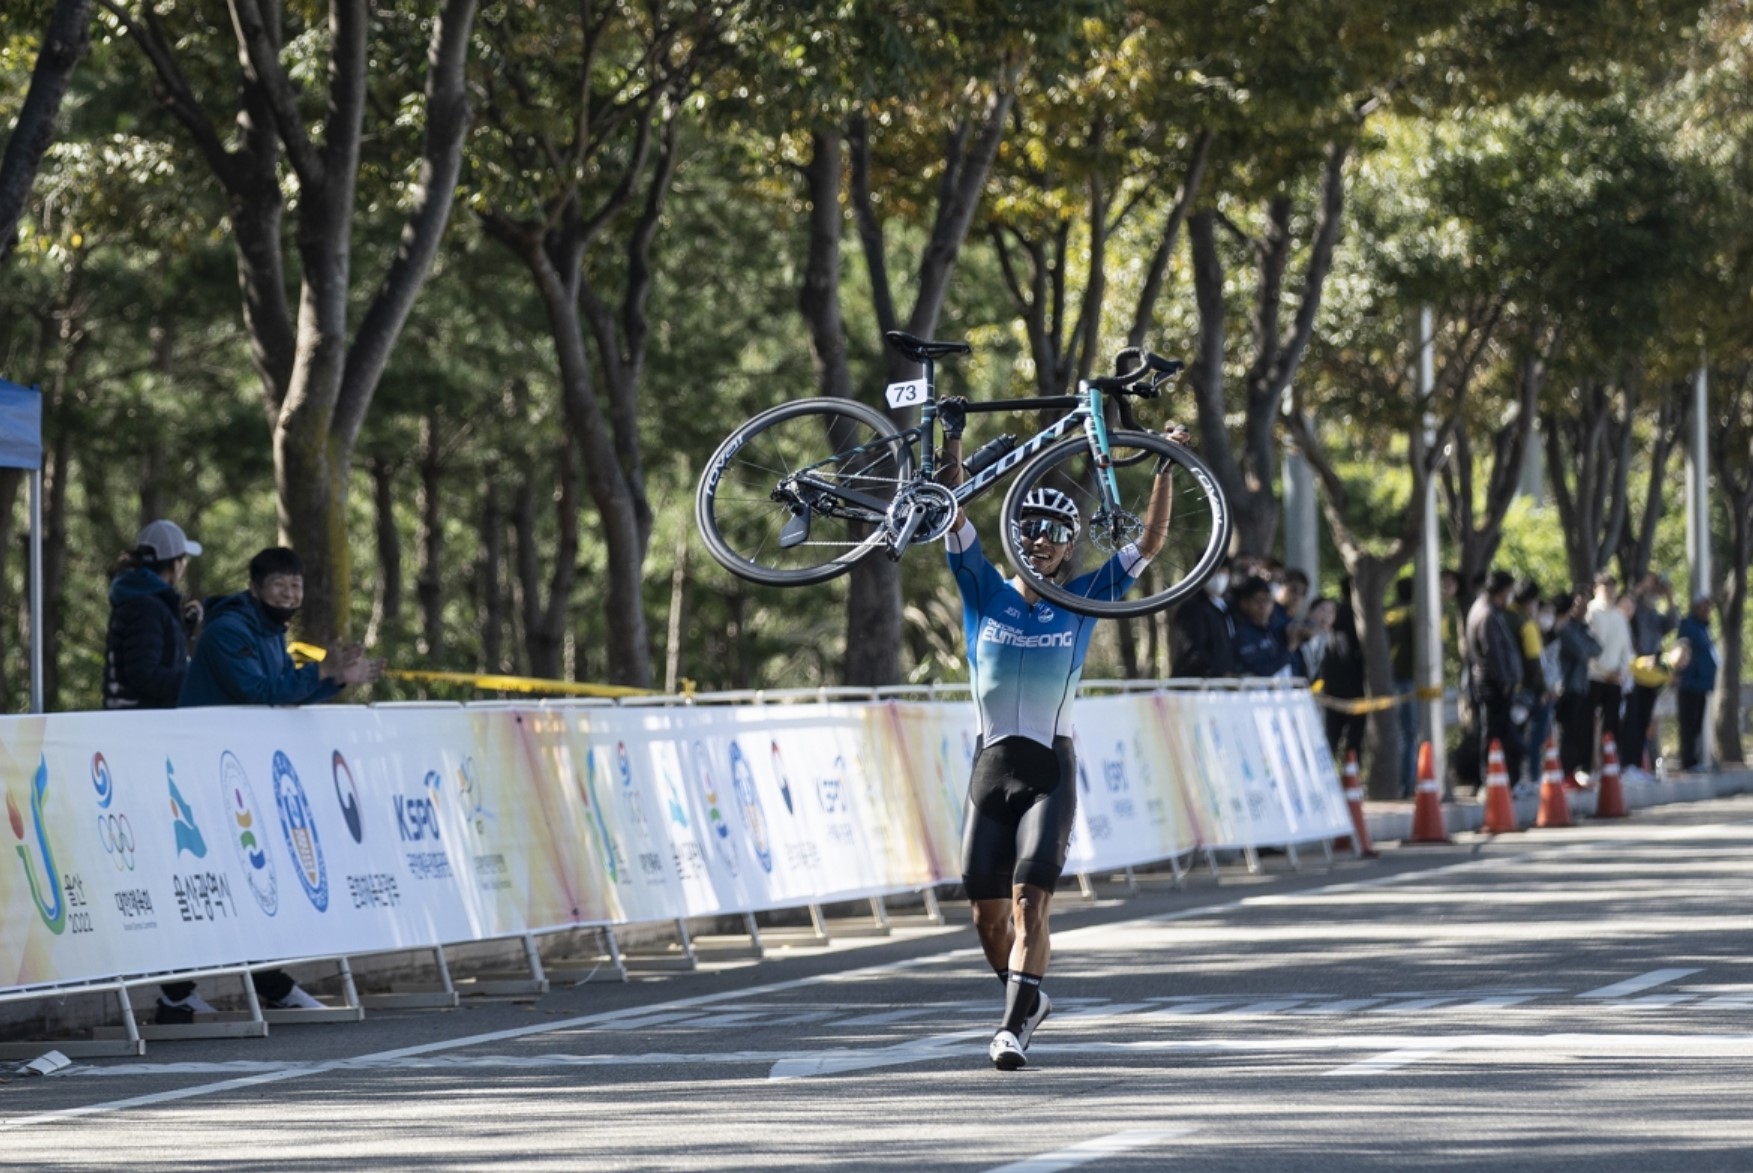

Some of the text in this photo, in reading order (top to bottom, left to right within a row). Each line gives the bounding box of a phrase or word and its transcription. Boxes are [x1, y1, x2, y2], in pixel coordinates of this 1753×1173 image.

[893, 385, 918, 403] 73
[953, 411, 1070, 503] SCOTT
[981, 627, 1073, 648] EUMSEONG
[393, 794, 440, 842] KSPO
[65, 872, 87, 907] 울산
[173, 871, 238, 922] 울산광역시
[68, 911, 95, 934] 2022
